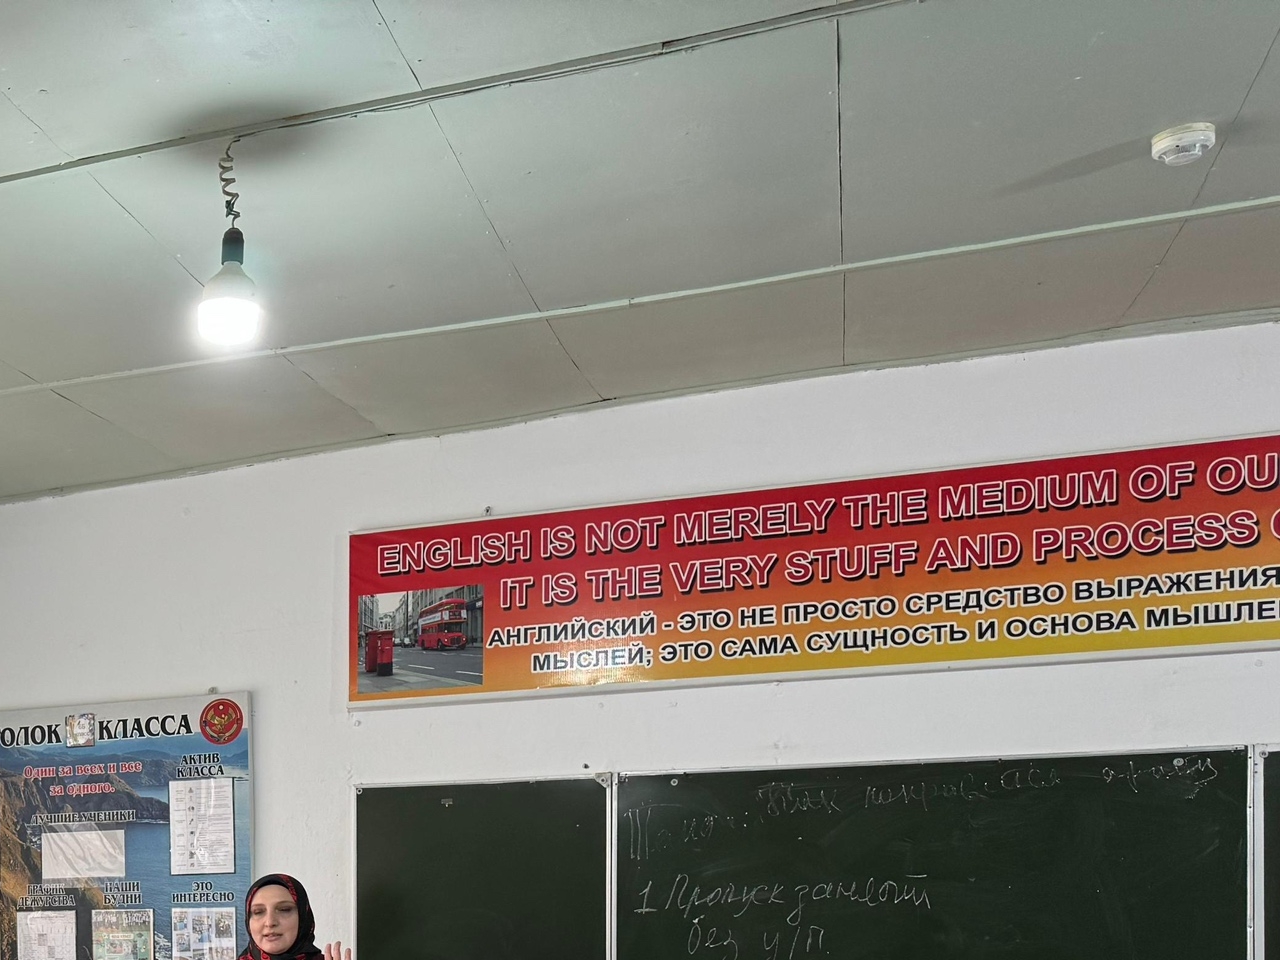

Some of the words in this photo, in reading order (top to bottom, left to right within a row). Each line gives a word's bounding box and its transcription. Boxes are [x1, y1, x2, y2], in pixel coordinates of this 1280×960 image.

[378, 529, 531, 575] ENGLISH
[540, 526, 576, 559] IS
[585, 516, 666, 553] NOT
[674, 499, 836, 545] MERELY
[842, 489, 927, 528] THE
[939, 469, 1117, 518] MEDIUM
[1129, 461, 1196, 500] OF
[1207, 453, 1280, 492] OU
[500, 576, 534, 609] IT
[542, 573, 577, 605] IS
[585, 564, 662, 600] THE
[669, 553, 777, 593] VERY
[785, 541, 918, 583] STUFF
[925, 532, 1021, 571] AND
[1033, 509, 1259, 562] PROCESS
[488, 611, 656, 648] АНГЛИЙСКИЙ
[679, 611, 731, 633] ЭТО
[739, 606, 776, 628] НЕ
[783, 597, 897, 624] ПРОСТО
[905, 583, 1065, 614] СРЕДСТВО
[1074, 565, 1280, 601] ВЫРАЖЕНИЯ
[532, 643, 654, 674] МЫСЛЕЙ;
[660, 641, 712, 663] ЭТО
[720, 635, 798, 658] САМА
[806, 622, 968, 652] СУЩНОСТЬ
[977, 620, 997, 641] И
[1005, 610, 1137, 639] ОСНОВА
[1145, 600, 1280, 629] МЫШЛЕ
[98, 714, 194, 741] КЛАССА
[181, 752, 220, 766] АКТИВ
[23, 765, 56, 781] Один
[59, 766, 72, 777] за
[76, 764, 105, 776] всех
[108, 763, 117, 774] и
[120, 761, 143, 773] все
[176, 764, 225, 778] КЛАССА
[49, 785, 64, 797] за
[67, 783, 115, 798] одного.
[31, 811, 80, 826] ЛУЧШИЕ
[81, 809, 136, 823] УЧЕНИКИ
[27, 883, 66, 896] ГРАФИК
[104, 881, 141, 893] НАШИ
[192, 881, 213, 892] ЭТО
[17, 895, 76, 909] ДЕЖУРСТВА
[103, 893, 142, 907] БУДНИ
[172, 892, 235, 903] ИНТЕРЕСНО
[665, 874, 785, 918] Пропуск
